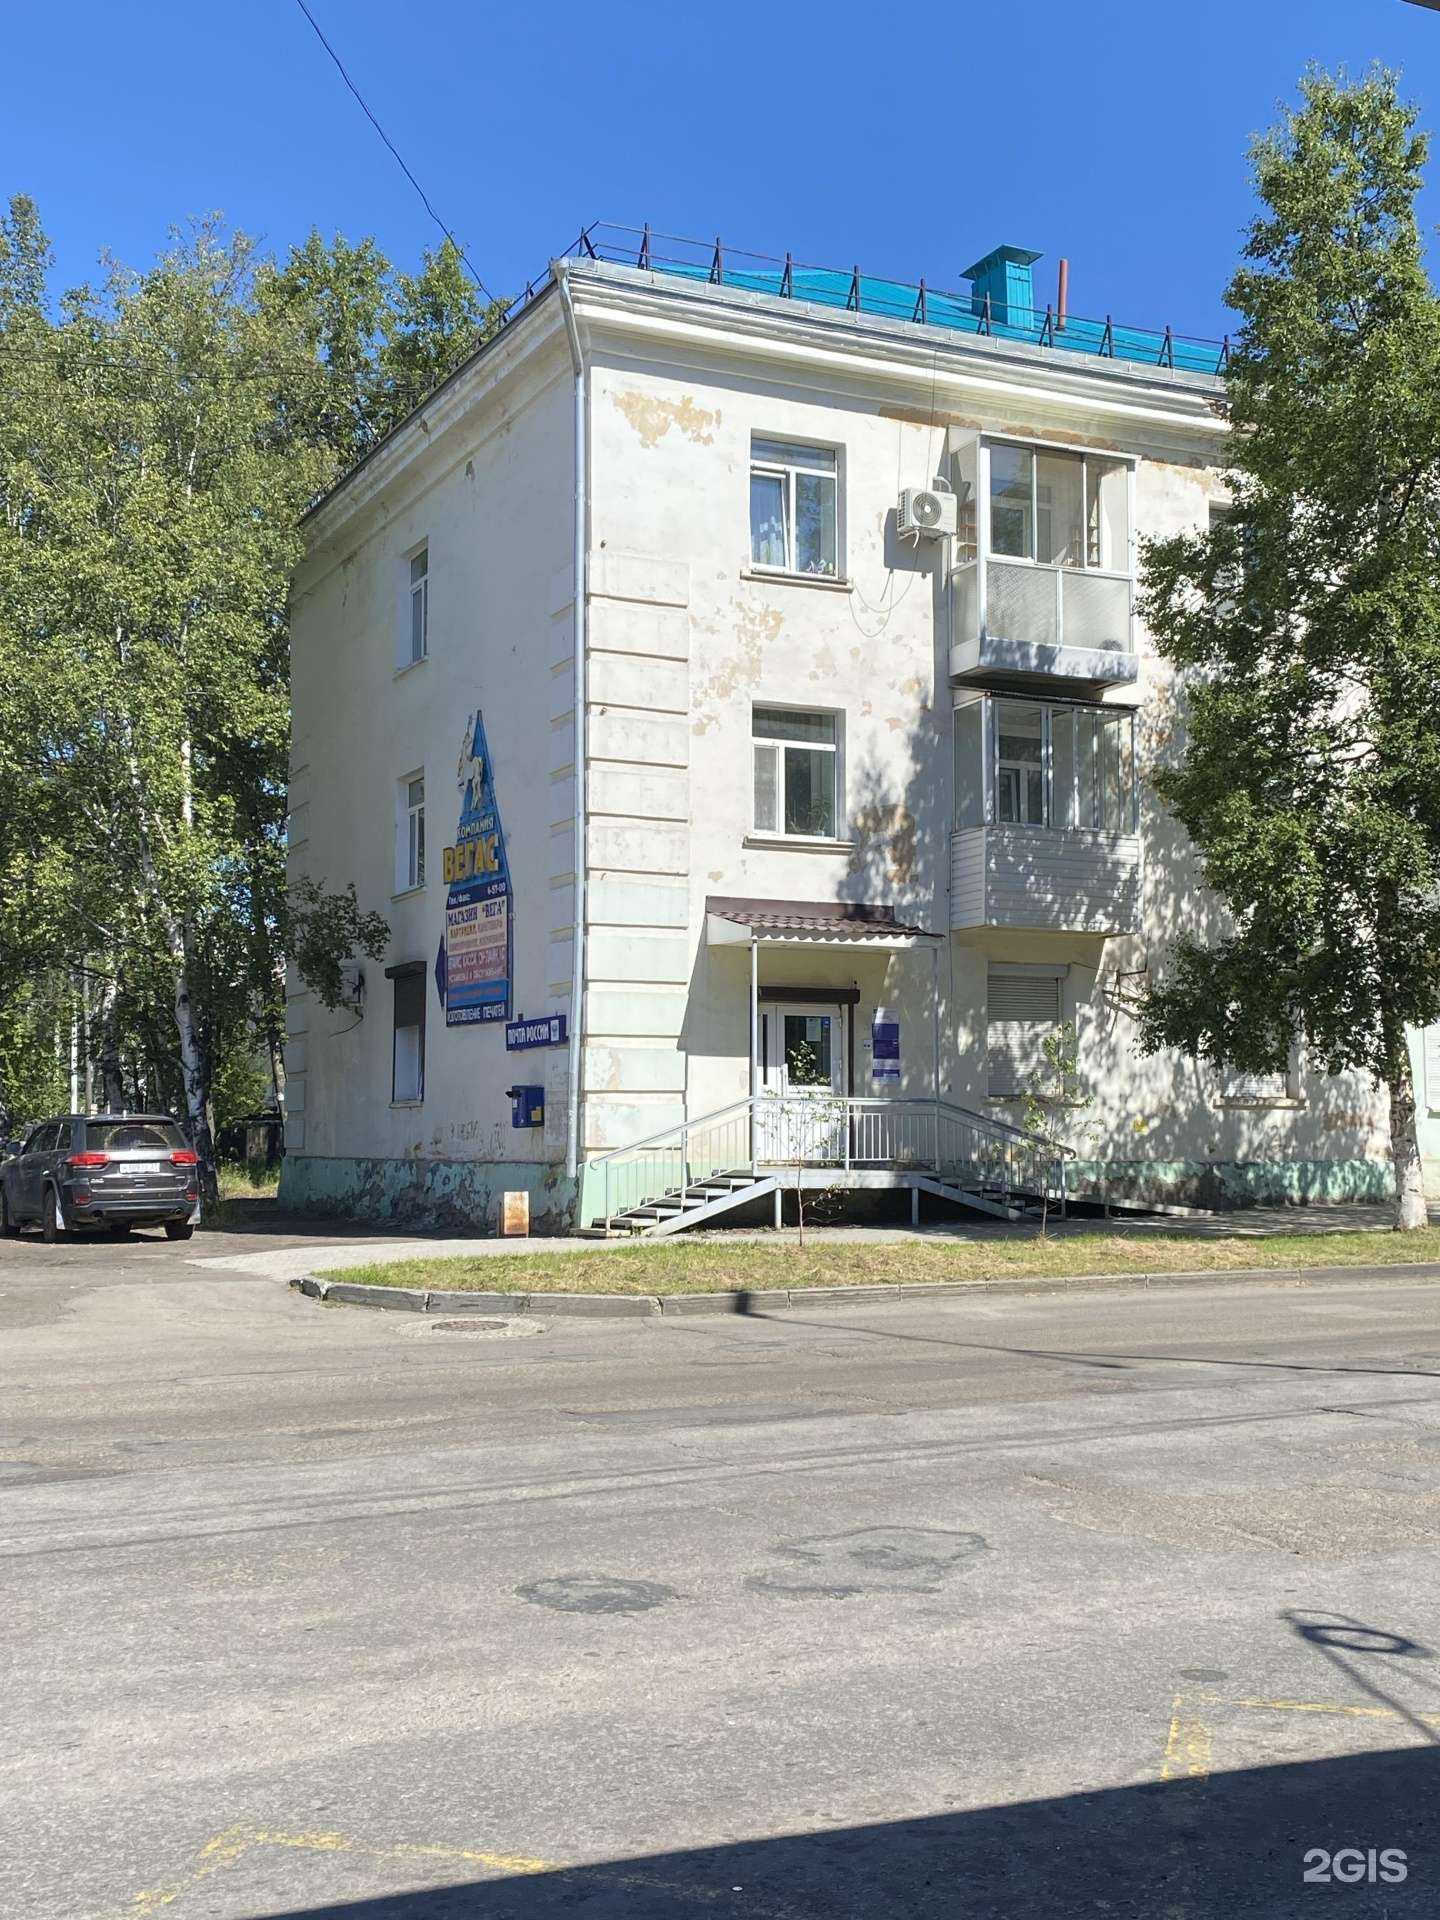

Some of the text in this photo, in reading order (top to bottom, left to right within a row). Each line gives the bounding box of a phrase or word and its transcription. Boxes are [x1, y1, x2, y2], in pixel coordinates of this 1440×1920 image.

[457, 817, 494, 838] КОМПАНИЯ
[443, 833, 499, 884] ВЕГАС
[448, 906, 478, 926] МАГАЗИН
[507, 1023, 549, 1045] ПОЧТА РОССИИ
